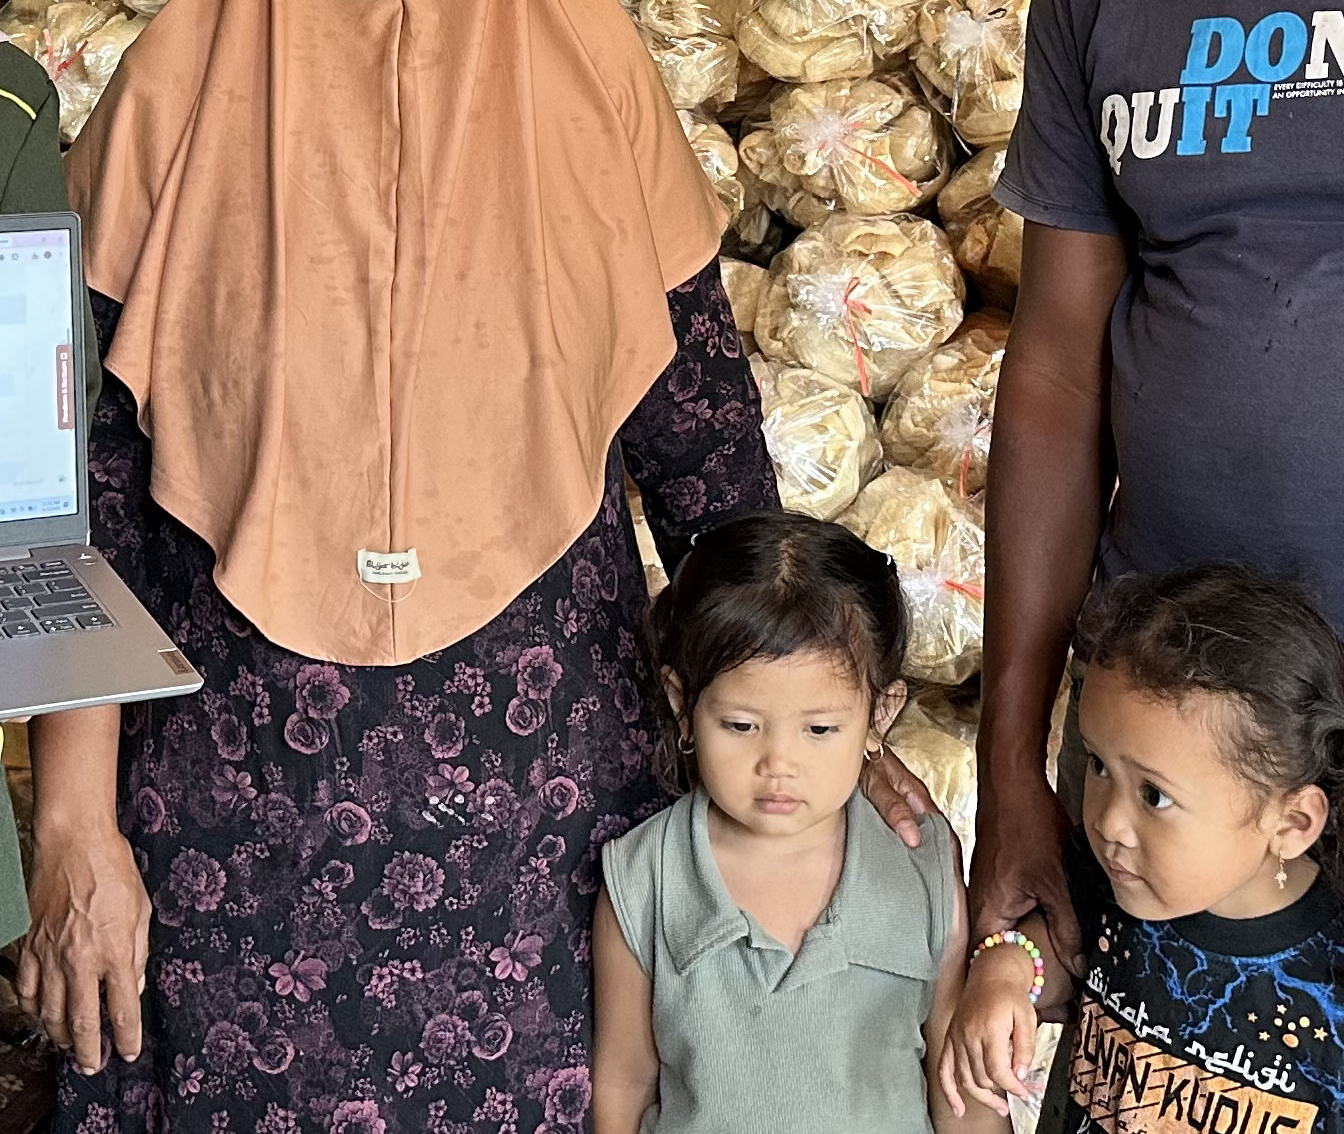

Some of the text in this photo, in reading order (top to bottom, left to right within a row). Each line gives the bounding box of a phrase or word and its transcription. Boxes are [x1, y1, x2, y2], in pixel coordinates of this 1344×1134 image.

[1100, 82, 1272, 176] QUIT
[1272, 92, 1284, 100] AN
[1285, 88, 1336, 99] OPPORTUNITY
[1073, 1009, 1152, 1104] UNAN
